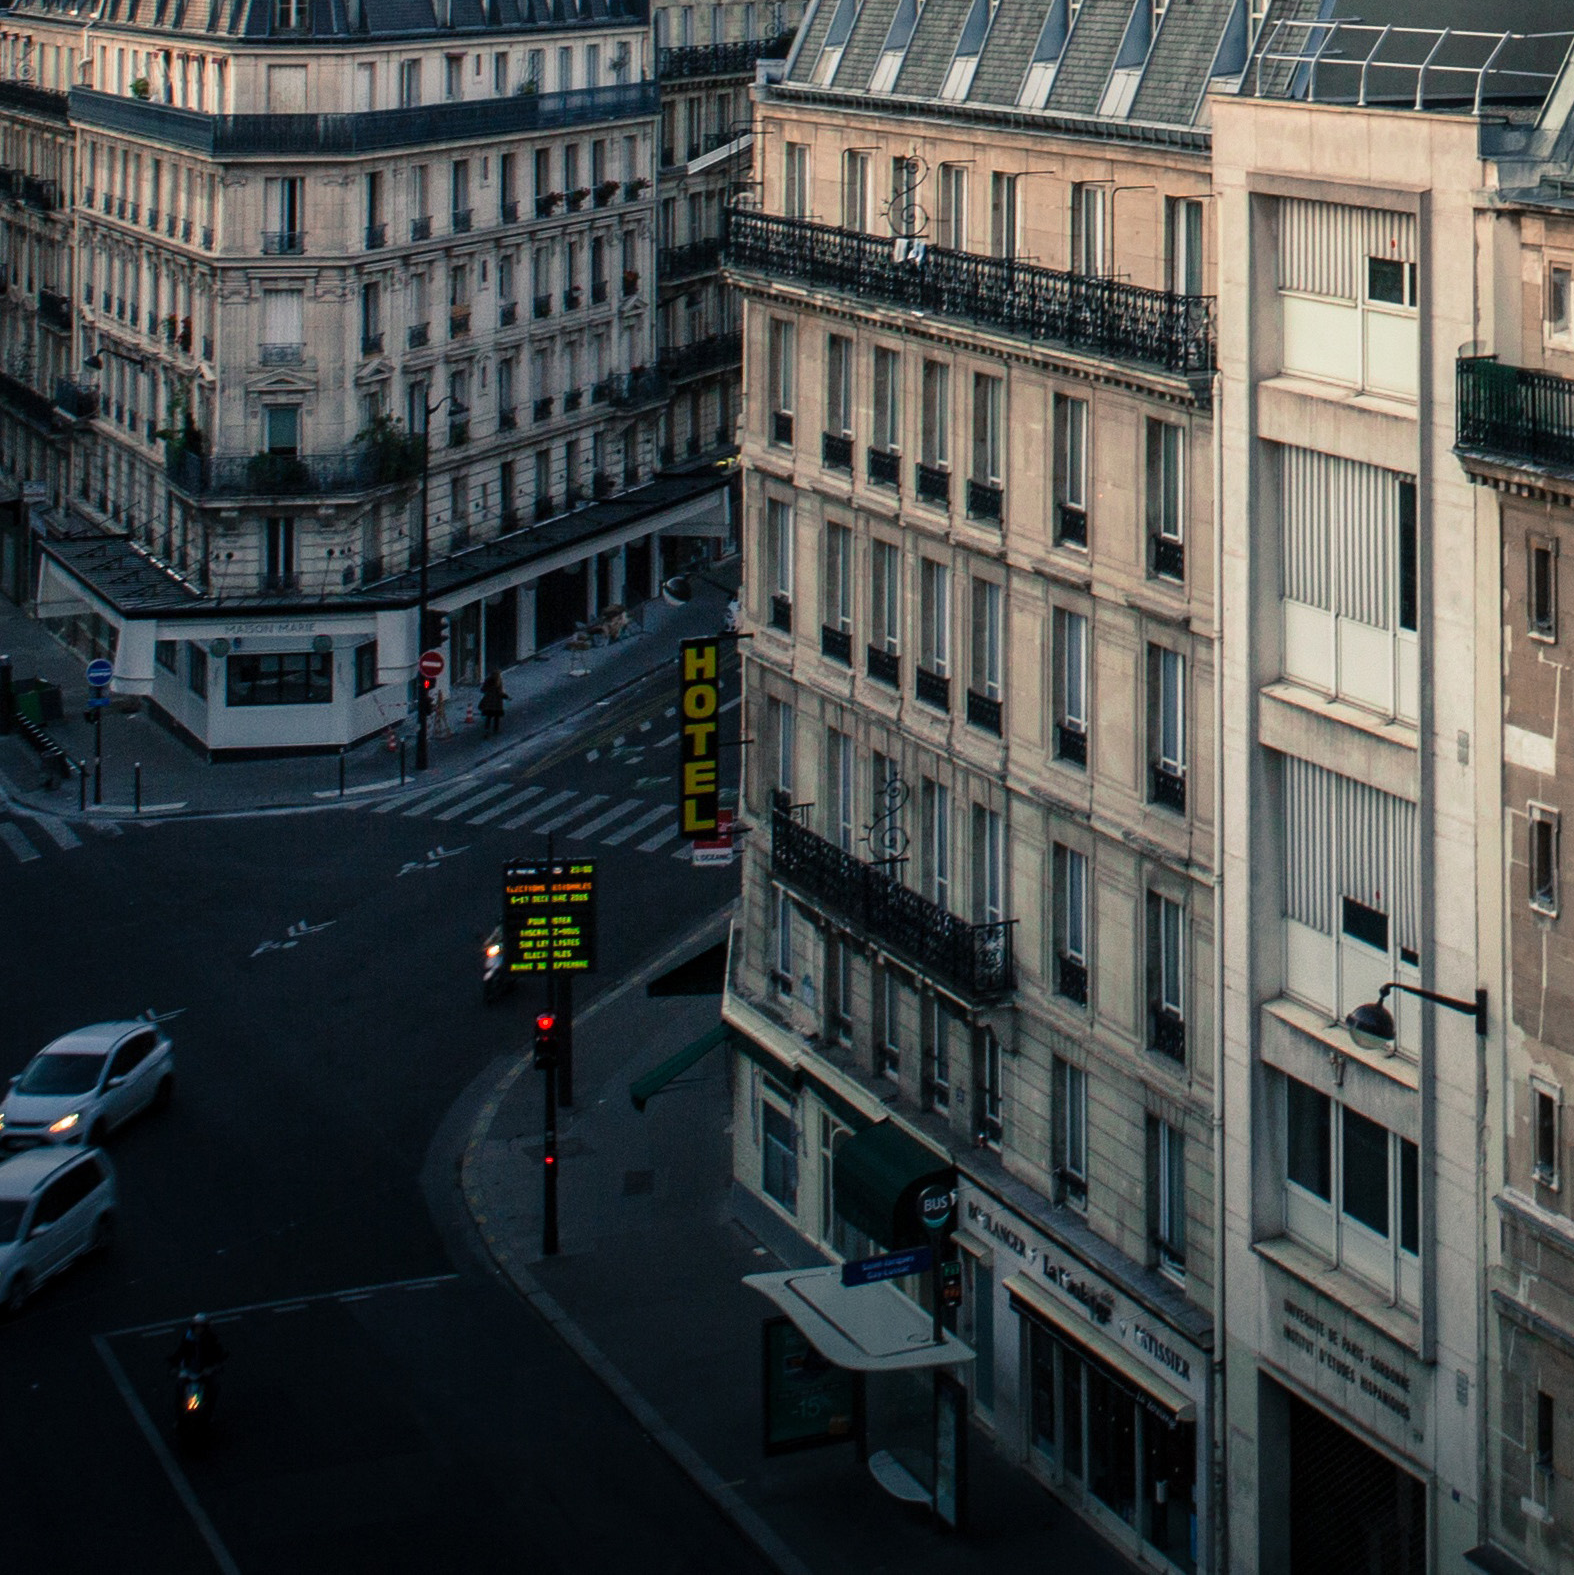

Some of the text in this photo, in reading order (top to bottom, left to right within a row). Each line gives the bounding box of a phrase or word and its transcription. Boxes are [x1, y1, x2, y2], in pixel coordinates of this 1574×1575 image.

[683, 645, 717, 832] HOTEL
[550, 916, 572, 925] OTER
[552, 960, 589, 971] EPTEMBRE
[923, 1194, 949, 1212] BUS
[1328, 1327, 1338, 1346] DE
